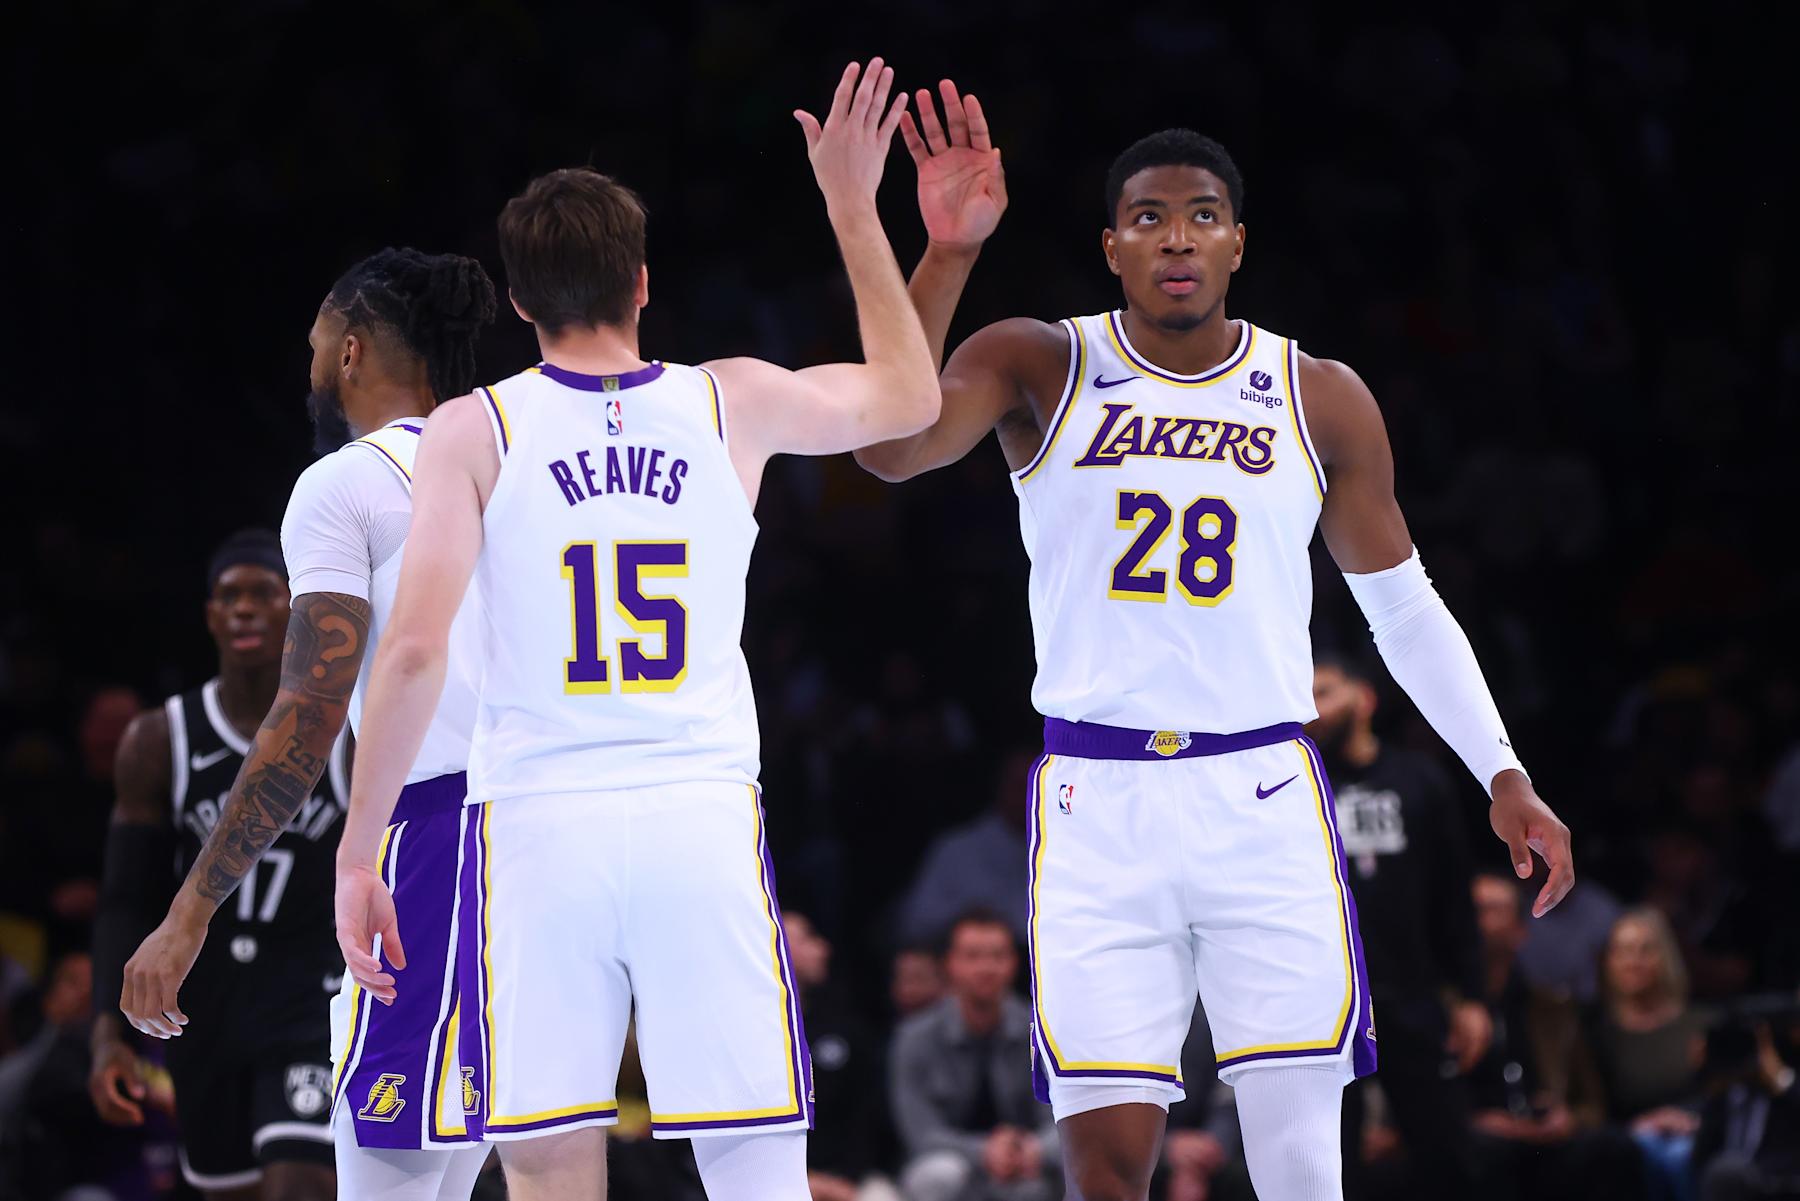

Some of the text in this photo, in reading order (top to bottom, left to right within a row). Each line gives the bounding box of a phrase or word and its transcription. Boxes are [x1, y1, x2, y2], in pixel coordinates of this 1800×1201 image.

[1240, 388, 1283, 409] bibigo
[1072, 402, 1278, 476] LAKERS
[548, 446, 689, 507] REAVES
[1107, 488, 1240, 608] 28
[560, 538, 690, 695] 15
[1147, 734, 1190, 750] LAKERS
[237, 849, 294, 922] 17
